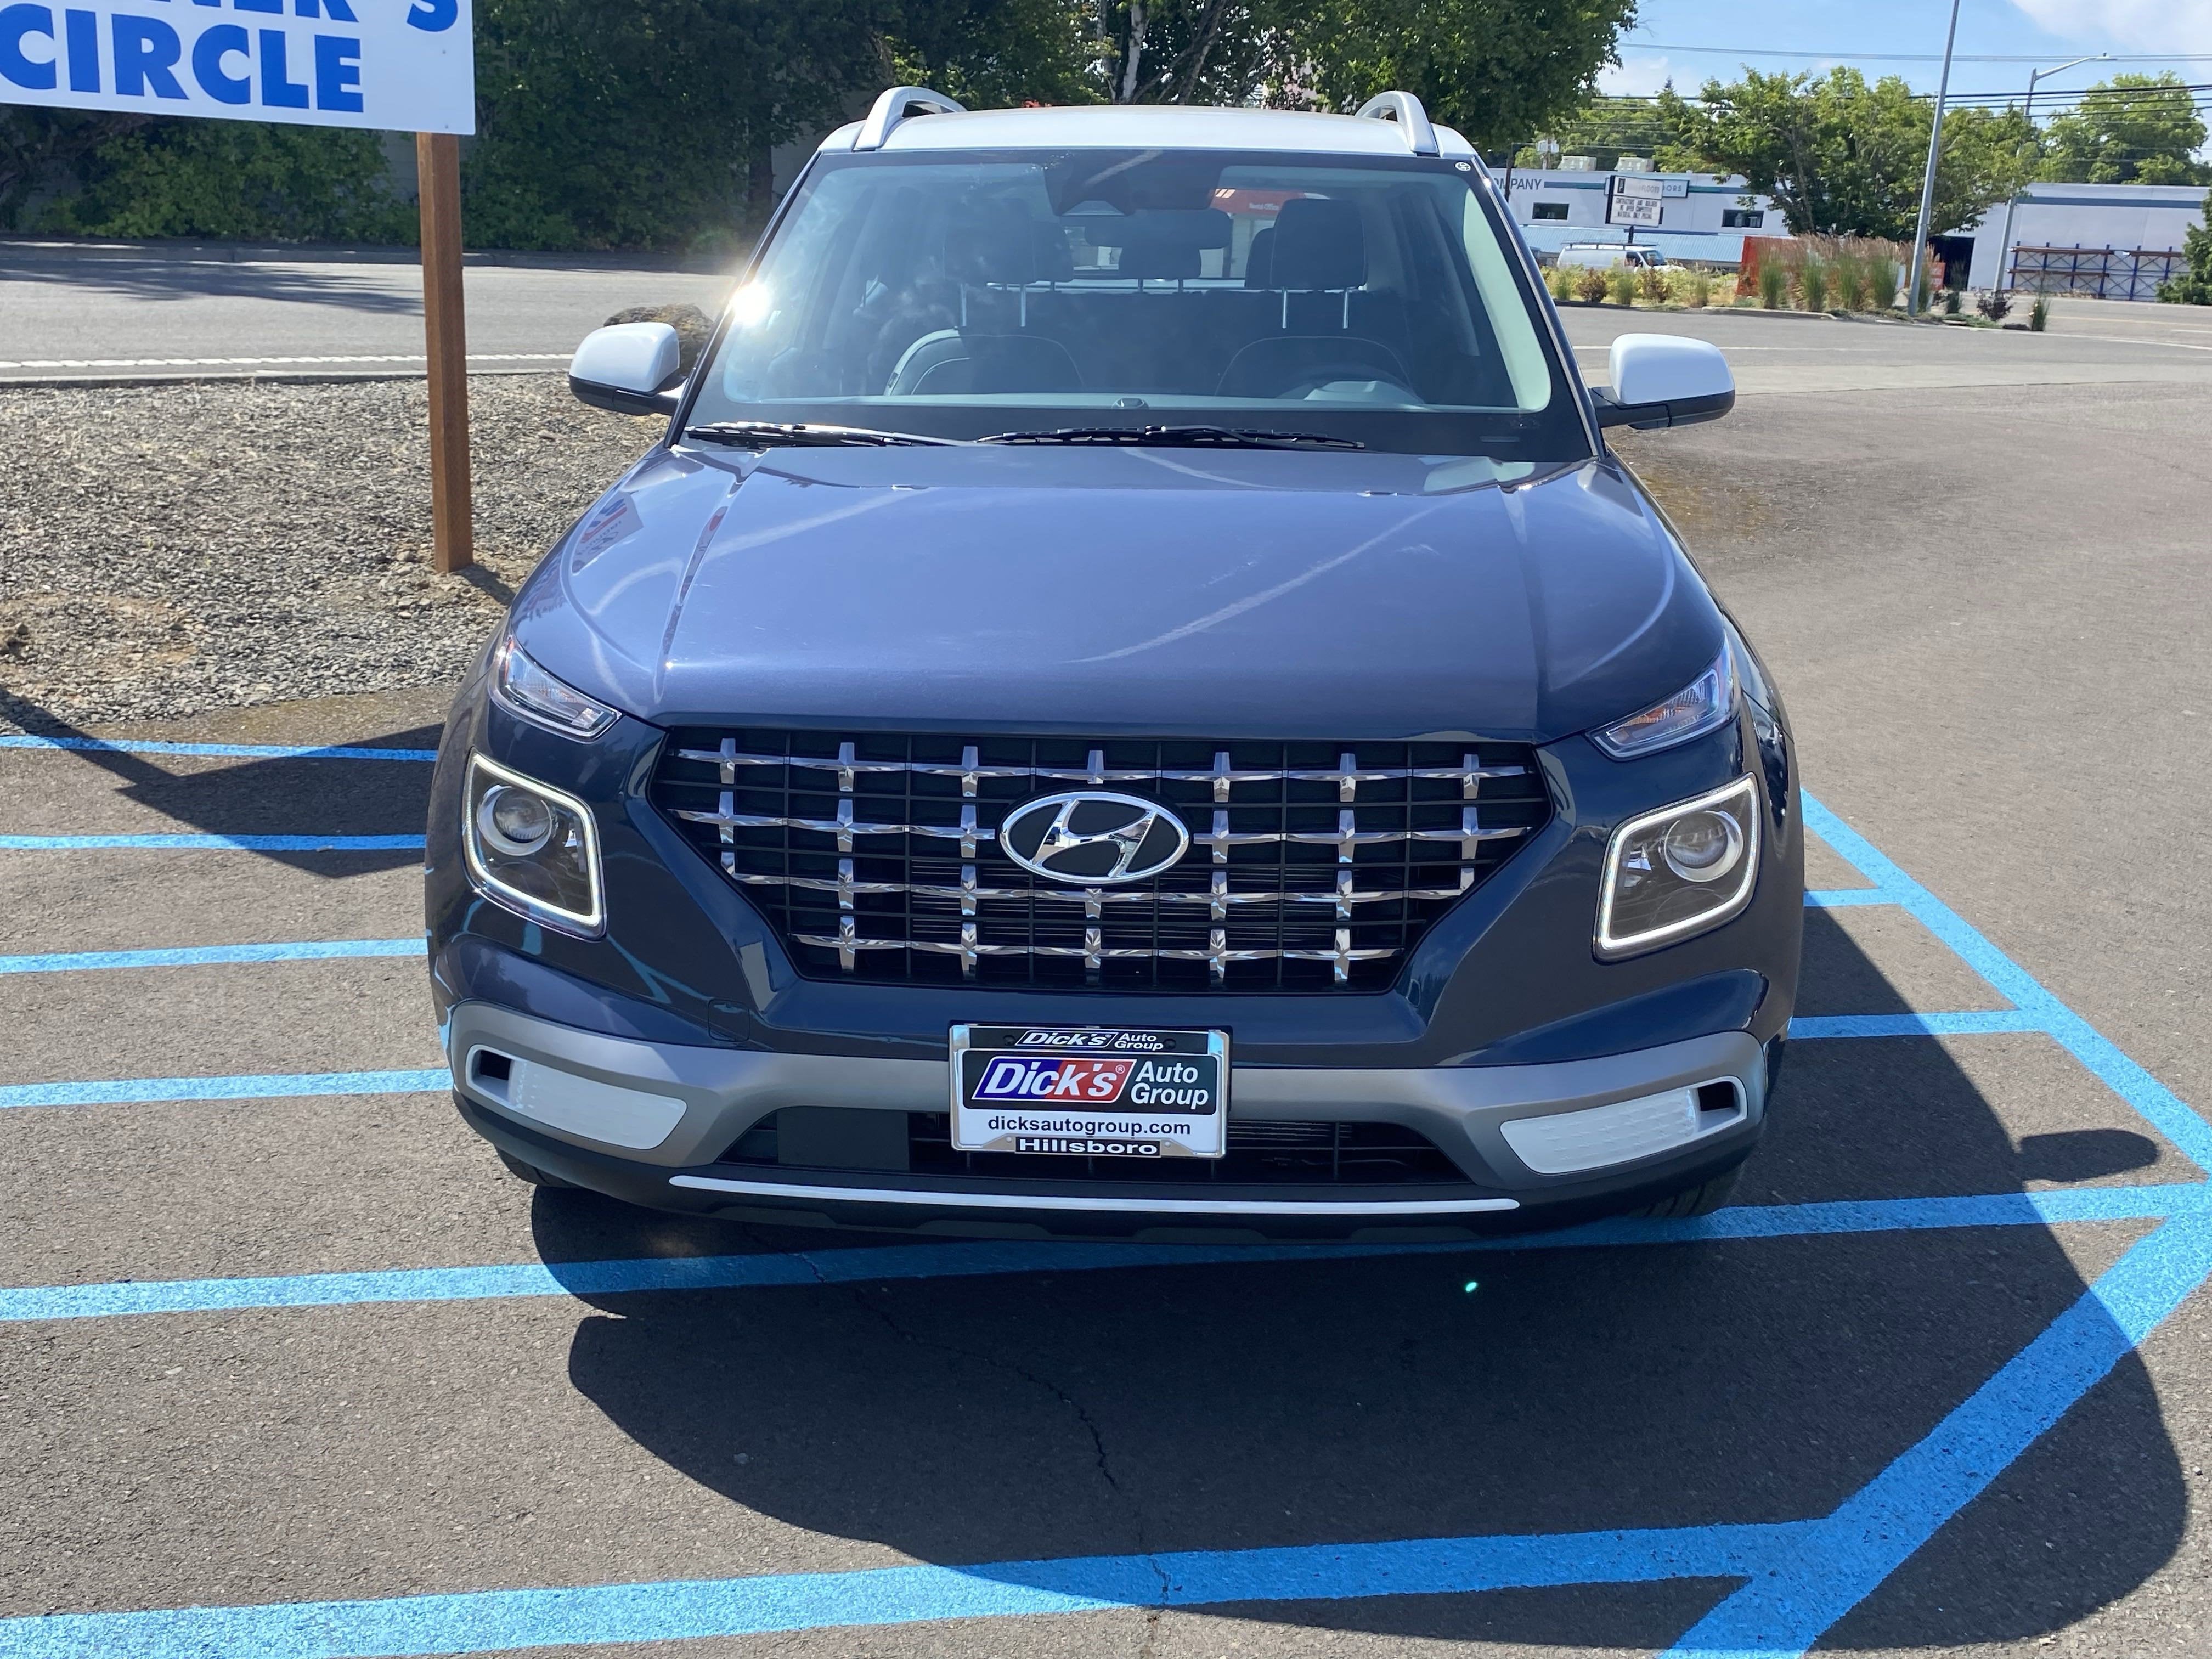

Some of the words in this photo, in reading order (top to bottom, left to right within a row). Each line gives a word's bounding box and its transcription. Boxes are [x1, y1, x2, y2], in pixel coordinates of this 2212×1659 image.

[0, 3, 364, 113] CIRCLE
[1114, 1041, 1164, 1051] Group
[1119, 1033, 1157, 1042] Auto
[1135, 1060, 1198, 1084] Auto
[1131, 1082, 1209, 1110] Group
[988, 1116, 1190, 1136] dicksautogroup.com
[1019, 1138, 1158, 1155] Hillsboro
